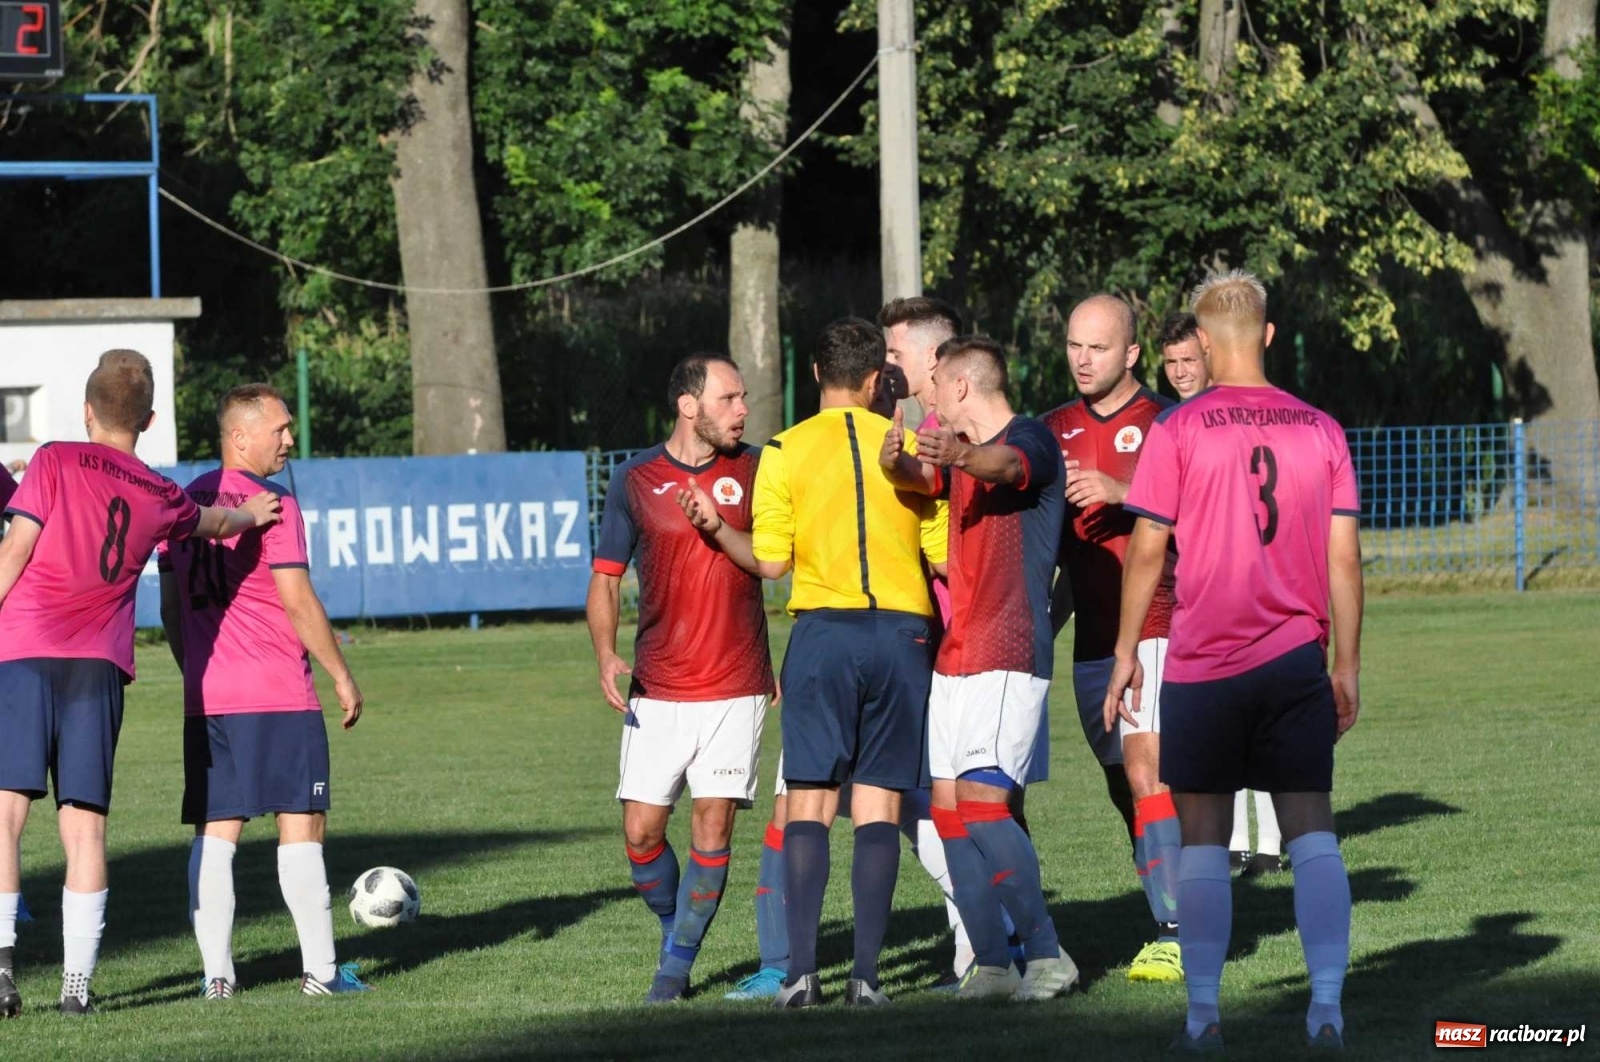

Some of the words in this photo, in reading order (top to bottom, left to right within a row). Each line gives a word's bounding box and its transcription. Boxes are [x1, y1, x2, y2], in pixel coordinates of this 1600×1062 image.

[16, 4, 45, 55] 2
[1201, 407, 1227, 429] LKS
[79, 452, 99, 471] LKS
[1250, 445, 1279, 547] 3
[99, 495, 131, 584] 8
[965, 747, 987, 757] JAKO
